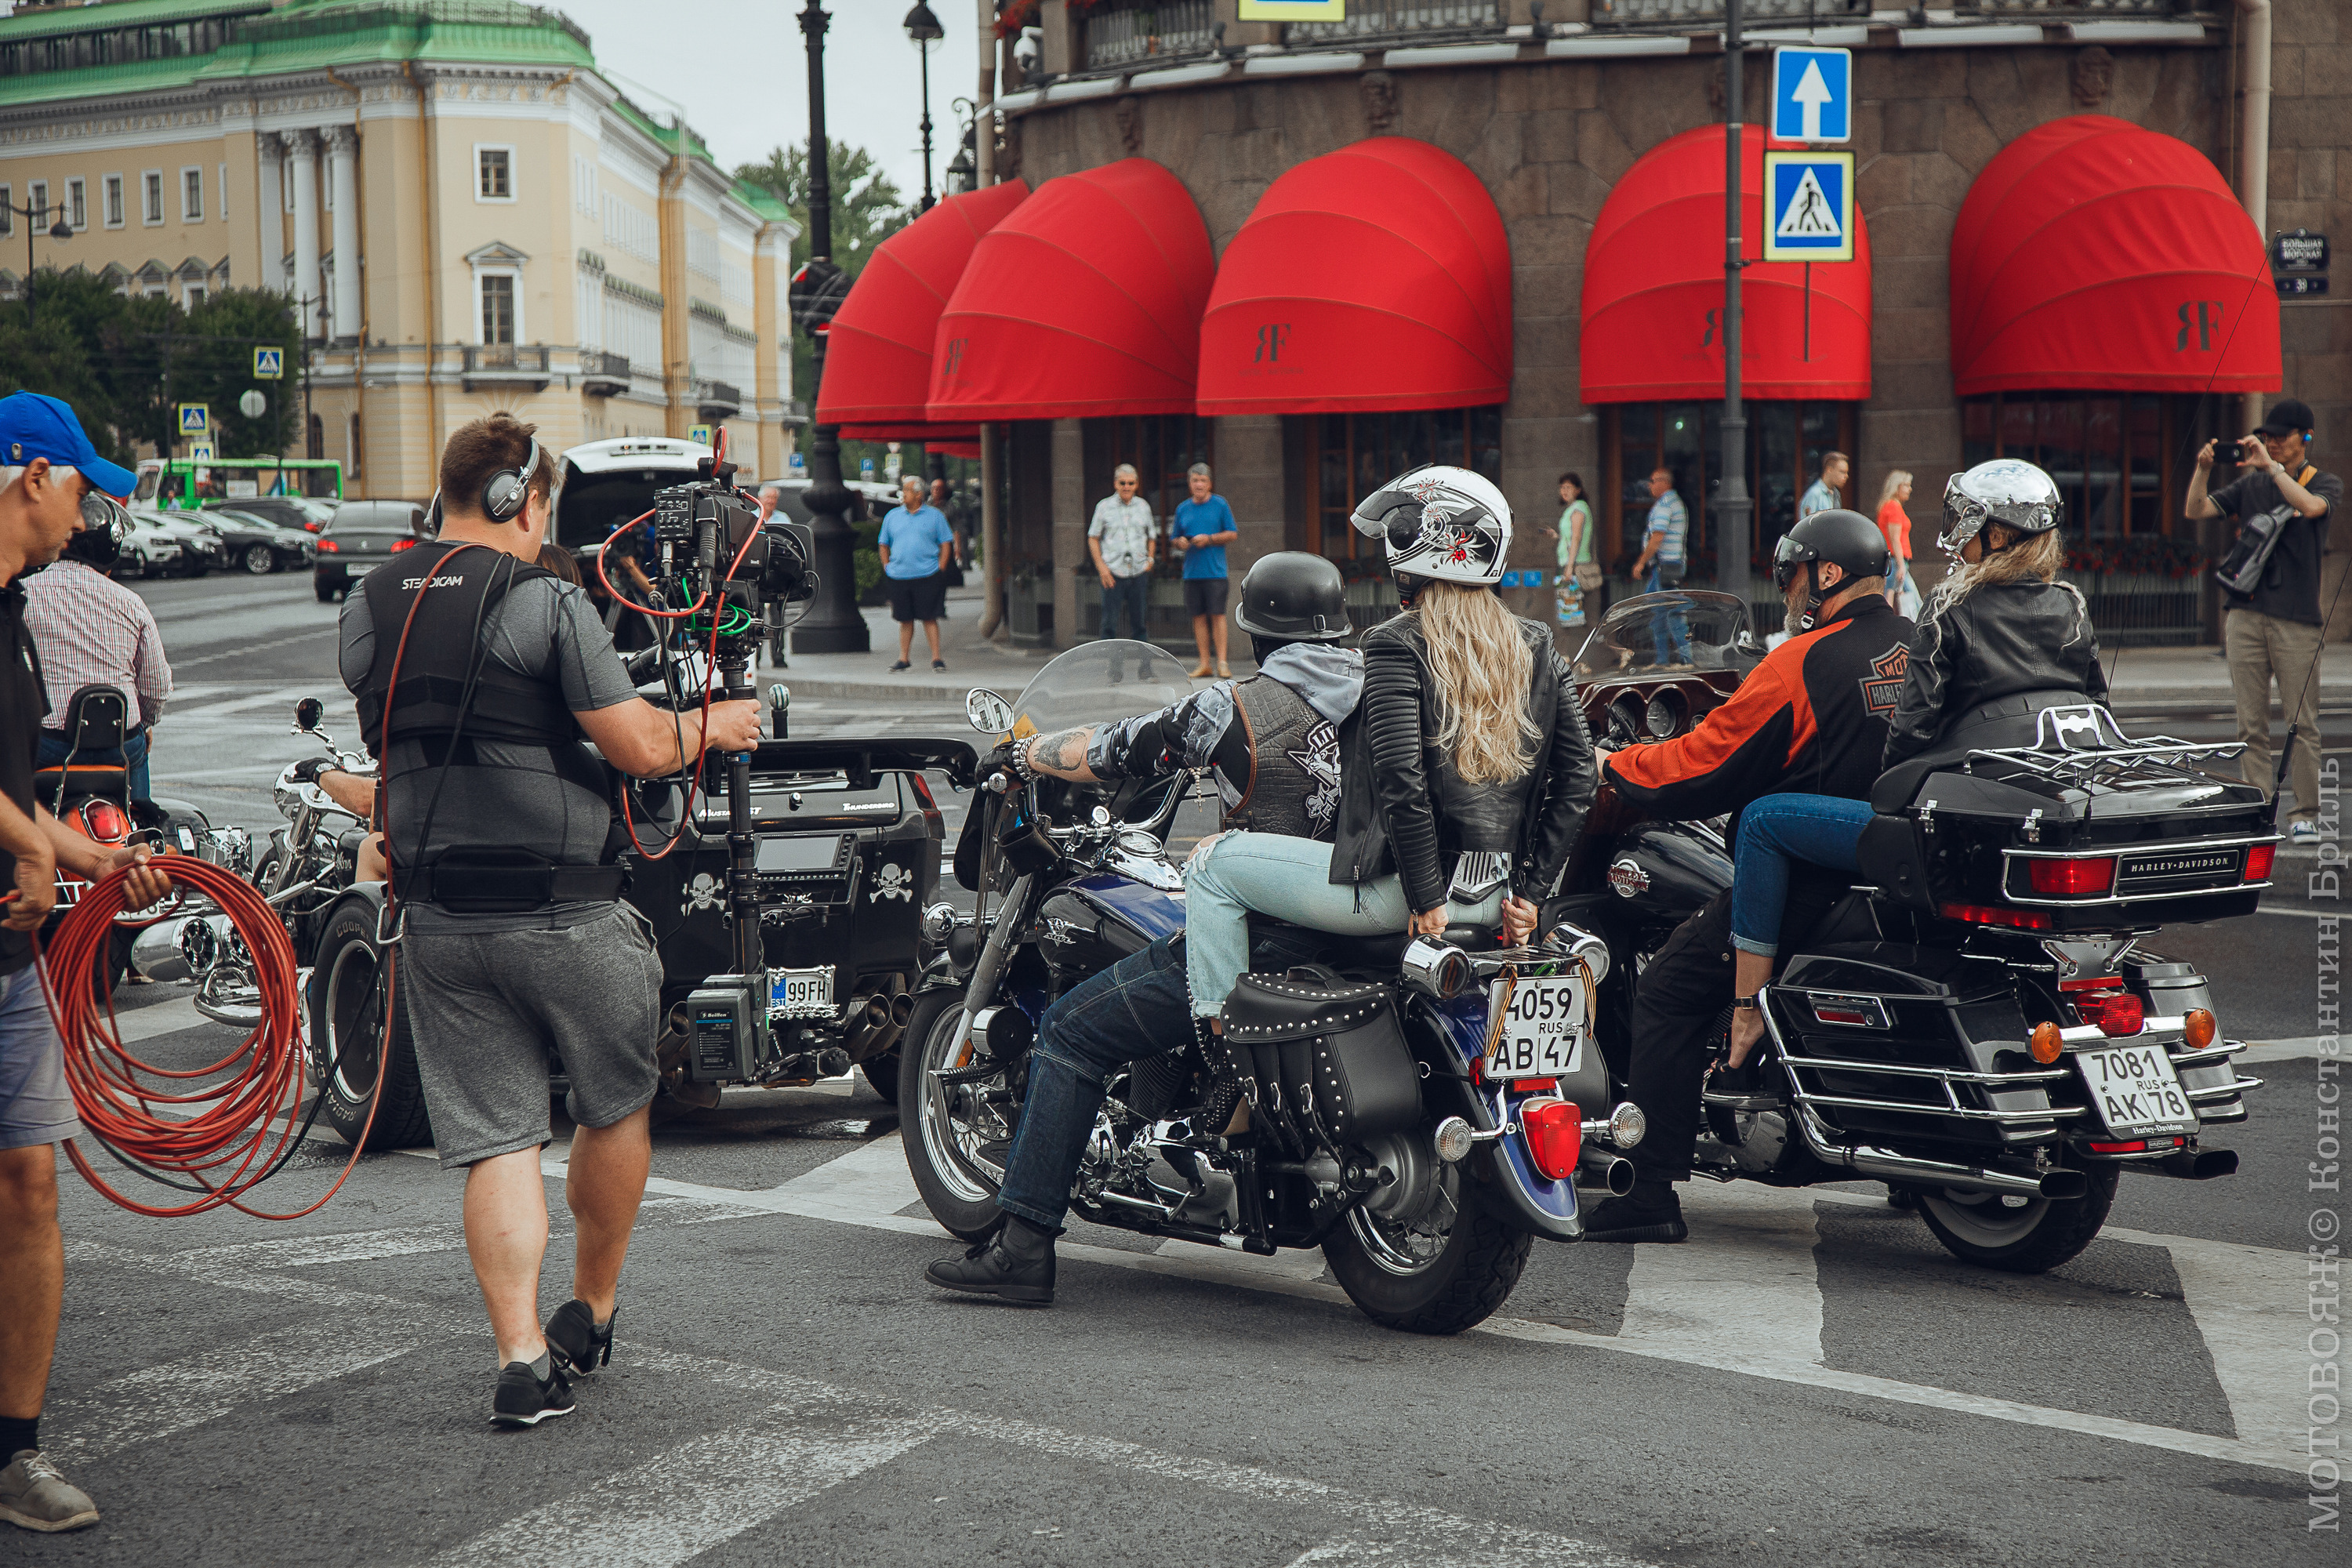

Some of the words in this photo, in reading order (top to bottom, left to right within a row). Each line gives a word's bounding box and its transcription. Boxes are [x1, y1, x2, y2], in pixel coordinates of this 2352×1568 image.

[2281, 238, 2323, 249] БОЛЬШАЯ
[2282, 249, 2322, 260] МОРСКАЯ
[1885, 653, 1907, 677] MOT
[842, 802, 895, 811] THUNDERBIRD
[771, 998, 785, 1009] EST
[1504, 986, 1573, 1022] 4059
[1539, 1022, 1564, 1035] RUS
[1544, 1035, 1577, 1068] 47
[2091, 1050, 2161, 1082] 7081
[2136, 1079, 2161, 1091] RUS
[2147, 1091, 2186, 1117] 78
[2132, 1122, 2184, 1134] Harley-Davidson
